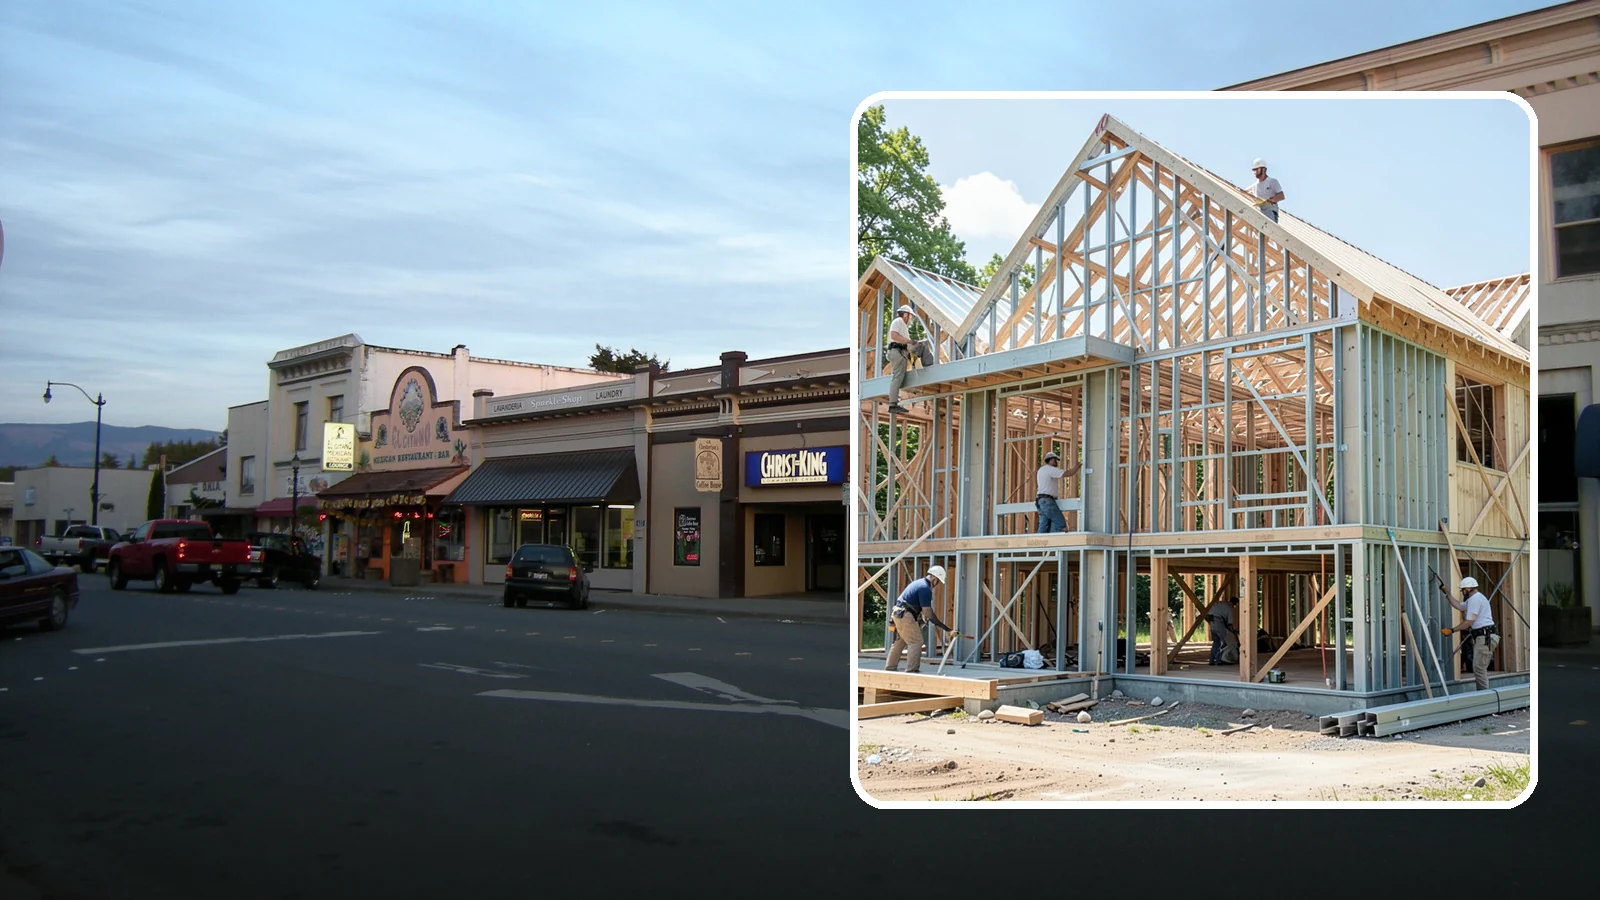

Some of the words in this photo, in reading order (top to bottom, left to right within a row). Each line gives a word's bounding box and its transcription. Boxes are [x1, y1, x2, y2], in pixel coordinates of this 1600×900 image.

[596, 389, 624, 400] LAUNDRY
[531, 399, 561, 409] Sparkle
[562, 395, 583, 405] Shop
[398, 451, 434, 462] RESTAURANT
[438, 450, 450, 459] BAR
